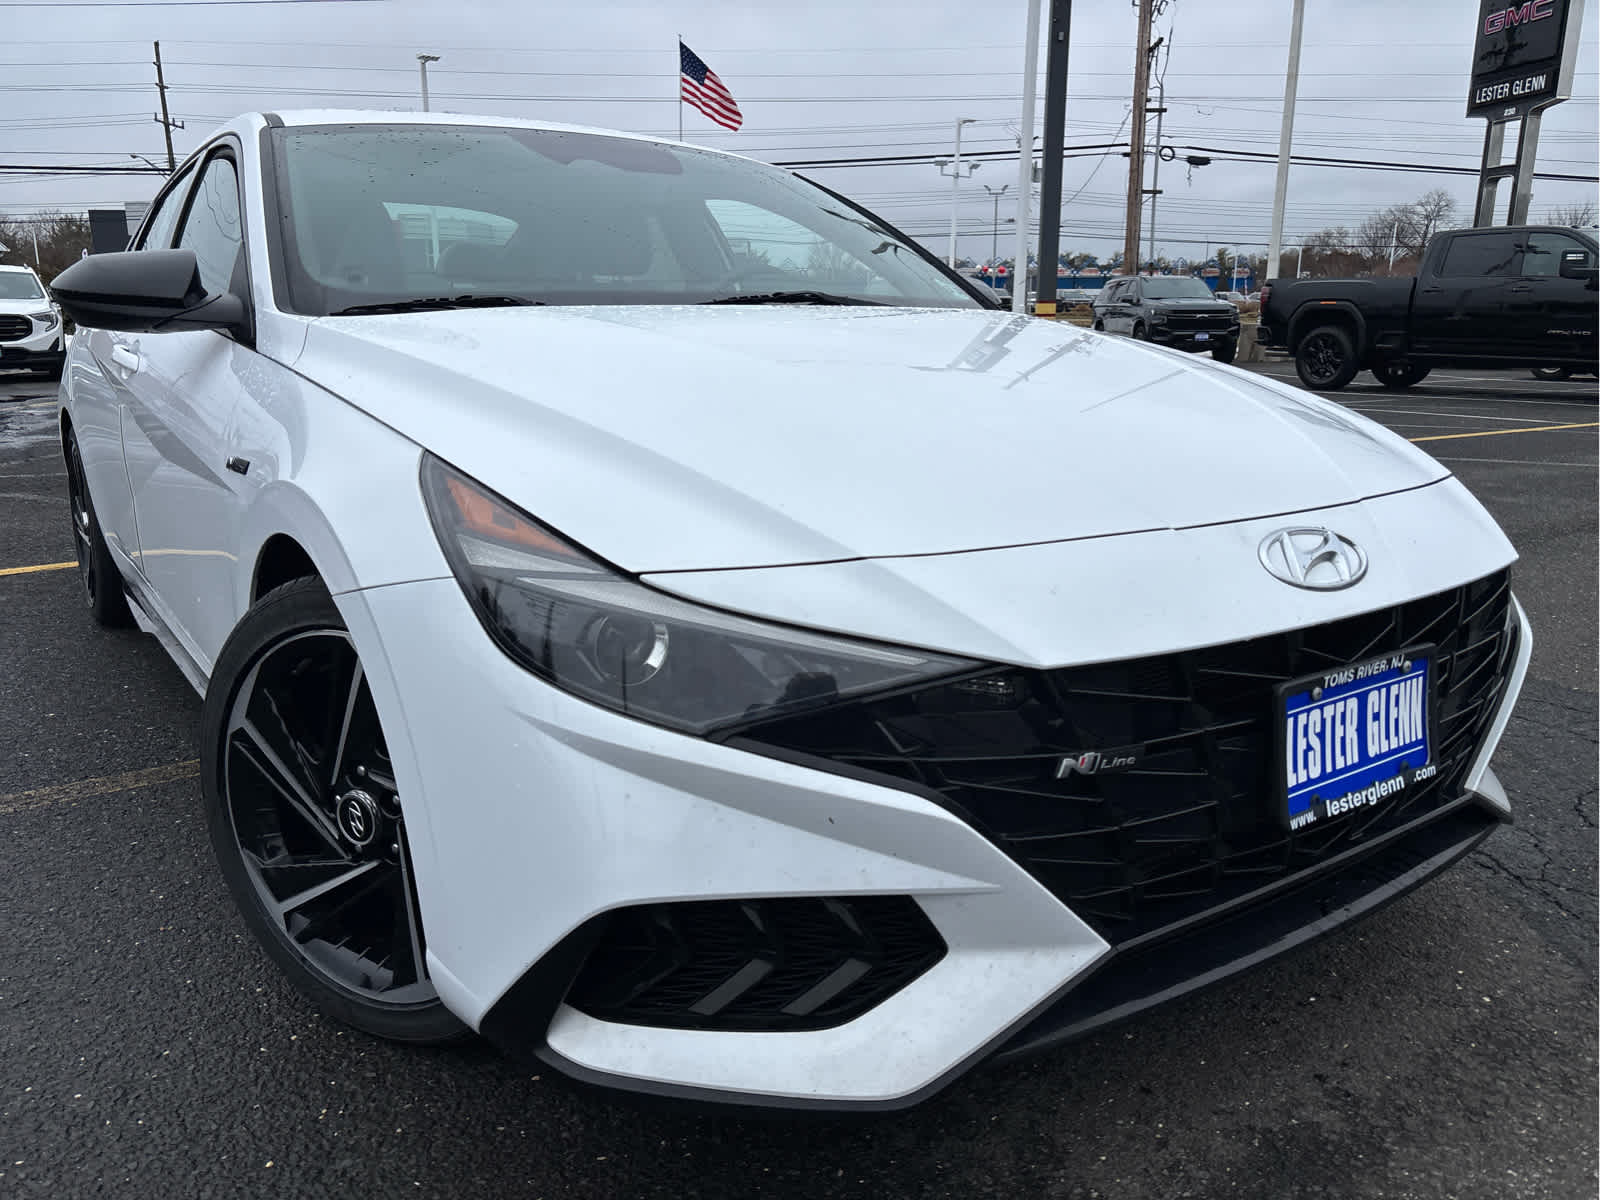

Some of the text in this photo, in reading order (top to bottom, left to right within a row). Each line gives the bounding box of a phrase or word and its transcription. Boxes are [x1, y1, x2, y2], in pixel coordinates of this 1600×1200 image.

[1484, 0, 1552, 34] GMC
[1475, 74, 1546, 103] LESTER GLENN
[1323, 654, 1405, 688] TOMS RIVER, NJ
[1287, 676, 1424, 788] LESTER GLENN
[1101, 756, 1136, 768] Line
[1326, 775, 1405, 817] lesterglenn
